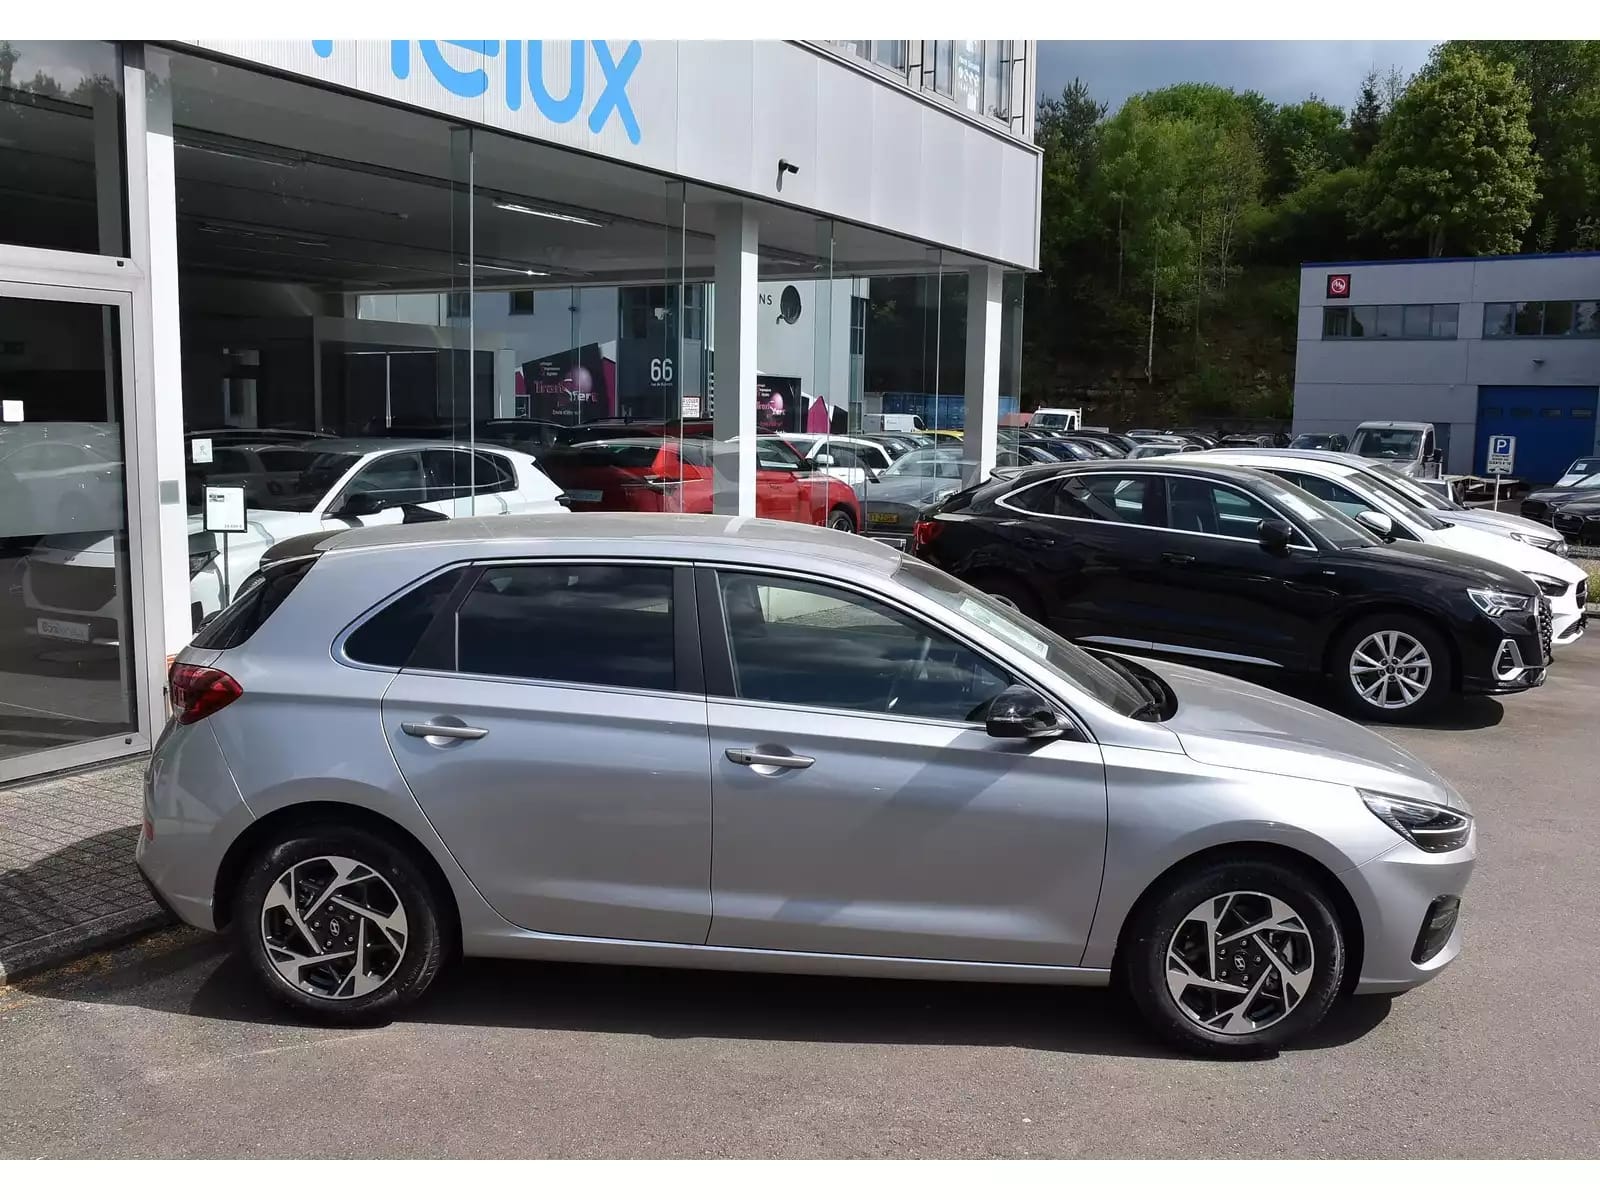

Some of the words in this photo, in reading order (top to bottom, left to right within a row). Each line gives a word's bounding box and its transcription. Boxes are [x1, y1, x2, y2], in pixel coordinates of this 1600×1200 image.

[312, 39, 642, 145] elux
[650, 358, 673, 382] 66
[1496, 439, 1507, 453] P
